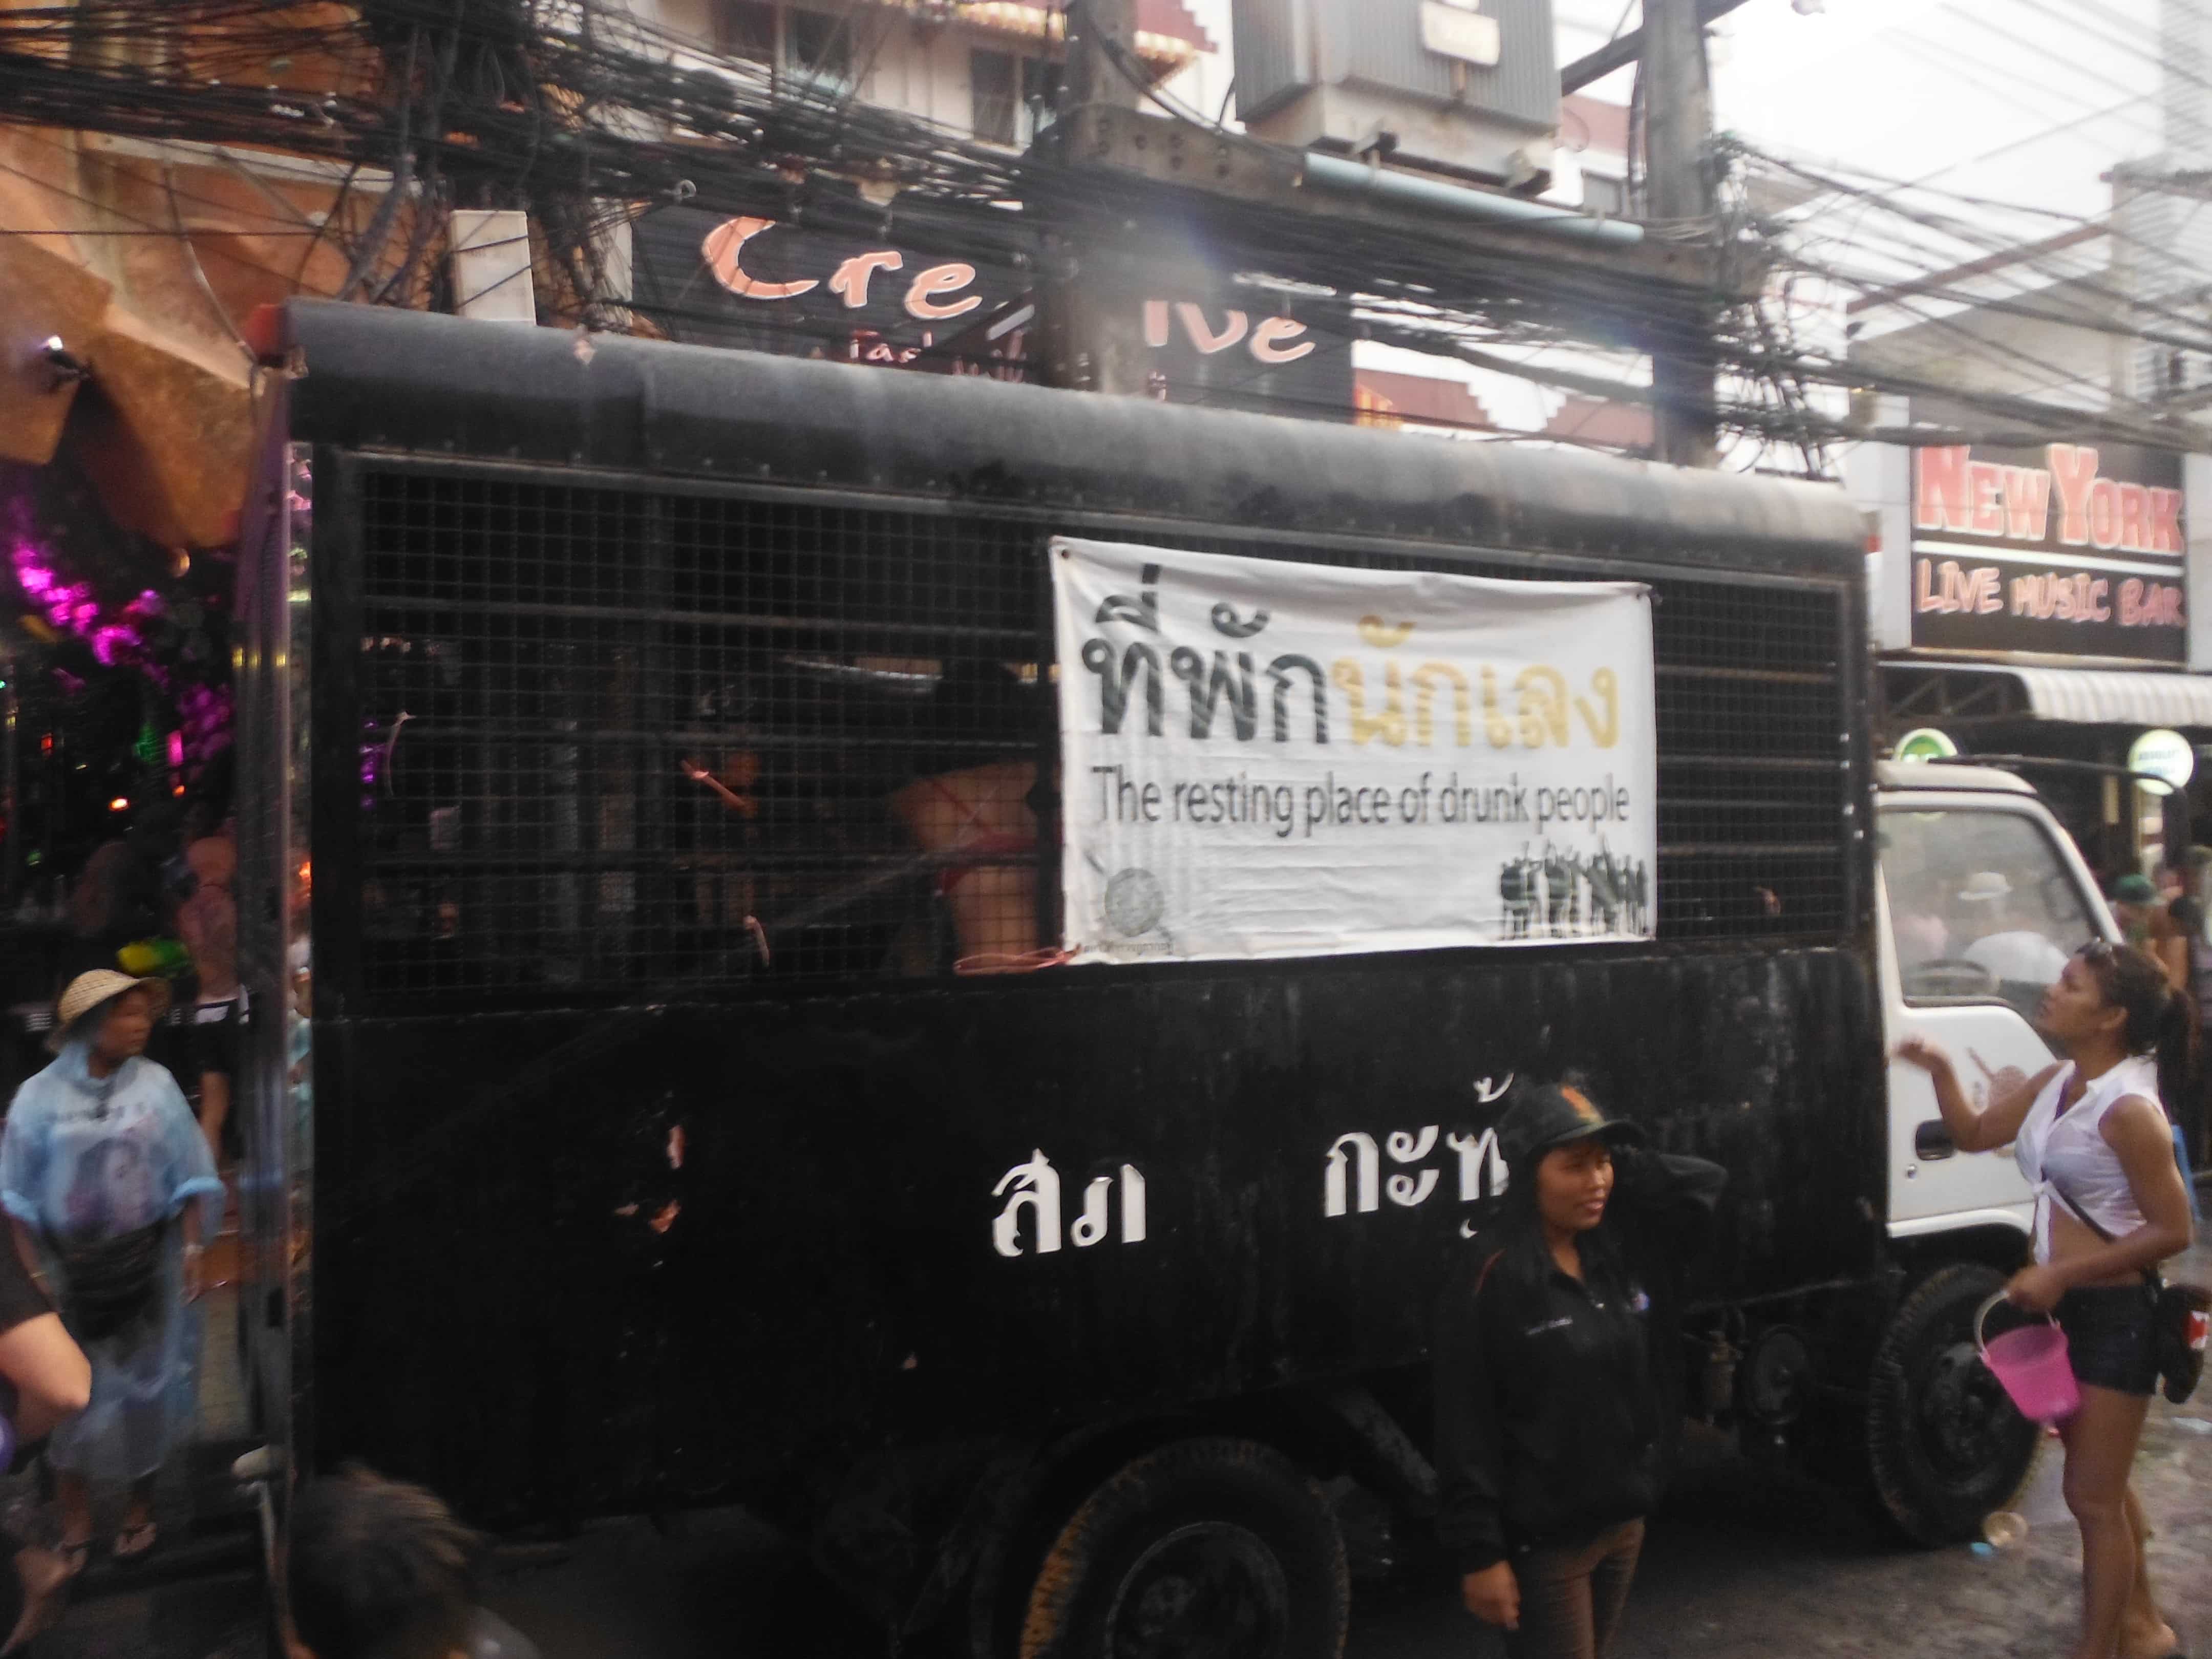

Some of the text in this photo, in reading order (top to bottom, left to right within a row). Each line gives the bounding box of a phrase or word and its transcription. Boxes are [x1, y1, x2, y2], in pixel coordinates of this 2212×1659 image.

[1916, 558, 2004, 614] LIVE
[2009, 571, 2112, 623] MUSIC
[1091, 763, 1630, 838] The resting place of drunk people
